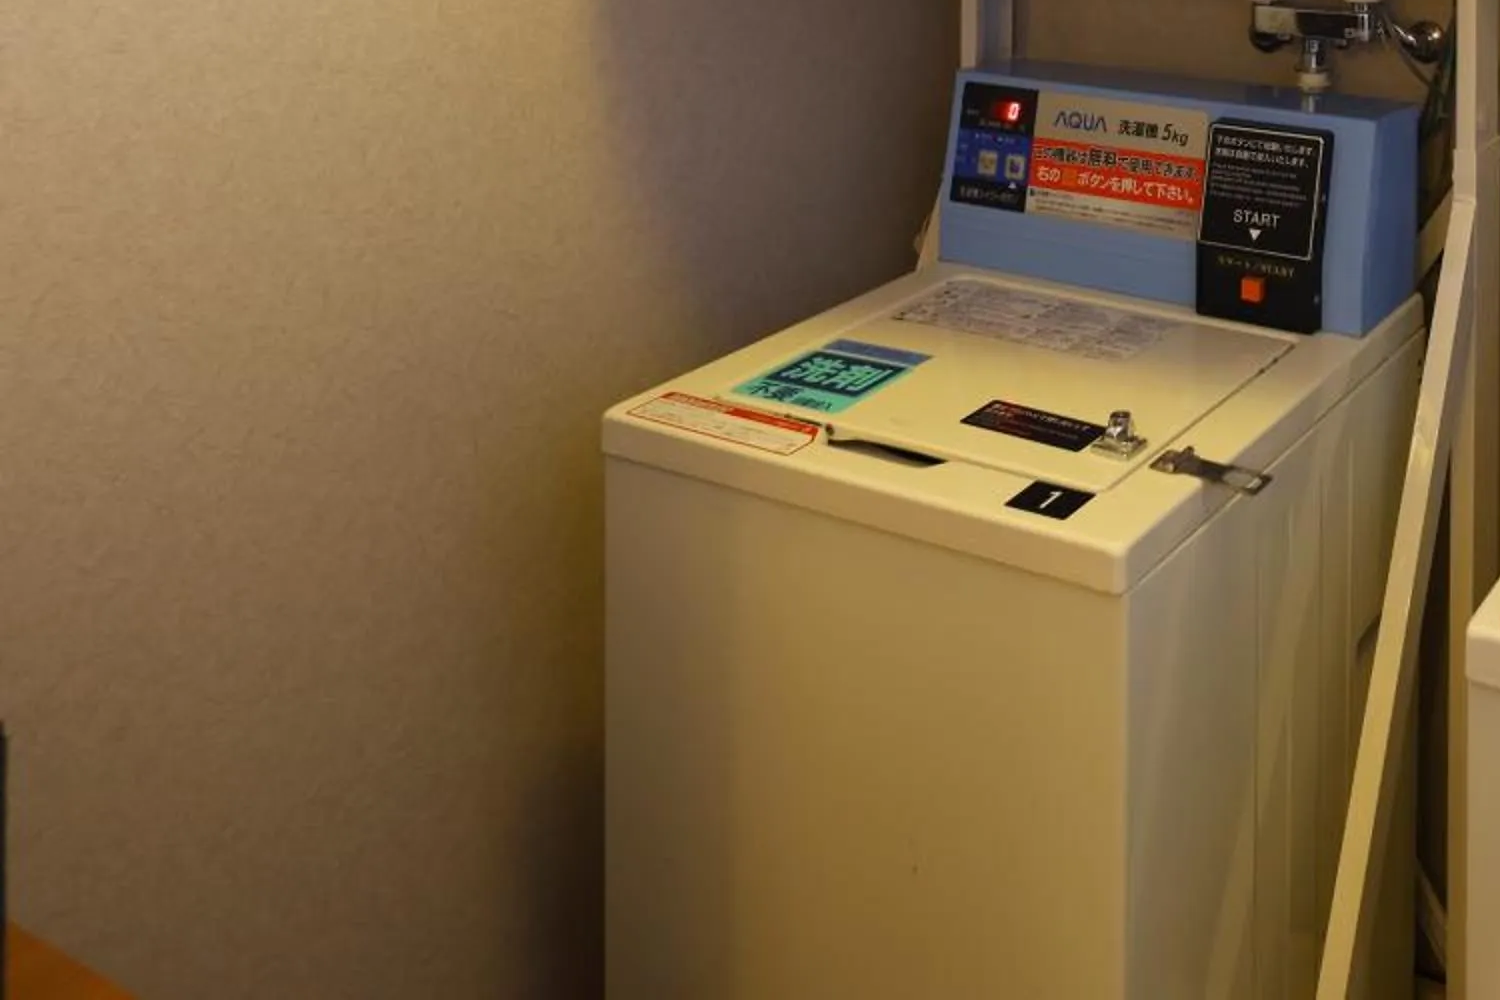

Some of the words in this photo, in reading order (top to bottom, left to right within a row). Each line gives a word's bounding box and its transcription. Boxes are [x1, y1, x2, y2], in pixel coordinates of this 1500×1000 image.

[1008, 102, 1020, 121] 0
[1053, 110, 1107, 133] AQUA
[1161, 123, 1190, 147] 5kg
[1036, 165, 1061, 183] 右の
[1077, 171, 1194, 204] ボタンを押して下さい。
[1233, 208, 1281, 230] START
[1039, 491, 1064, 509] 1
